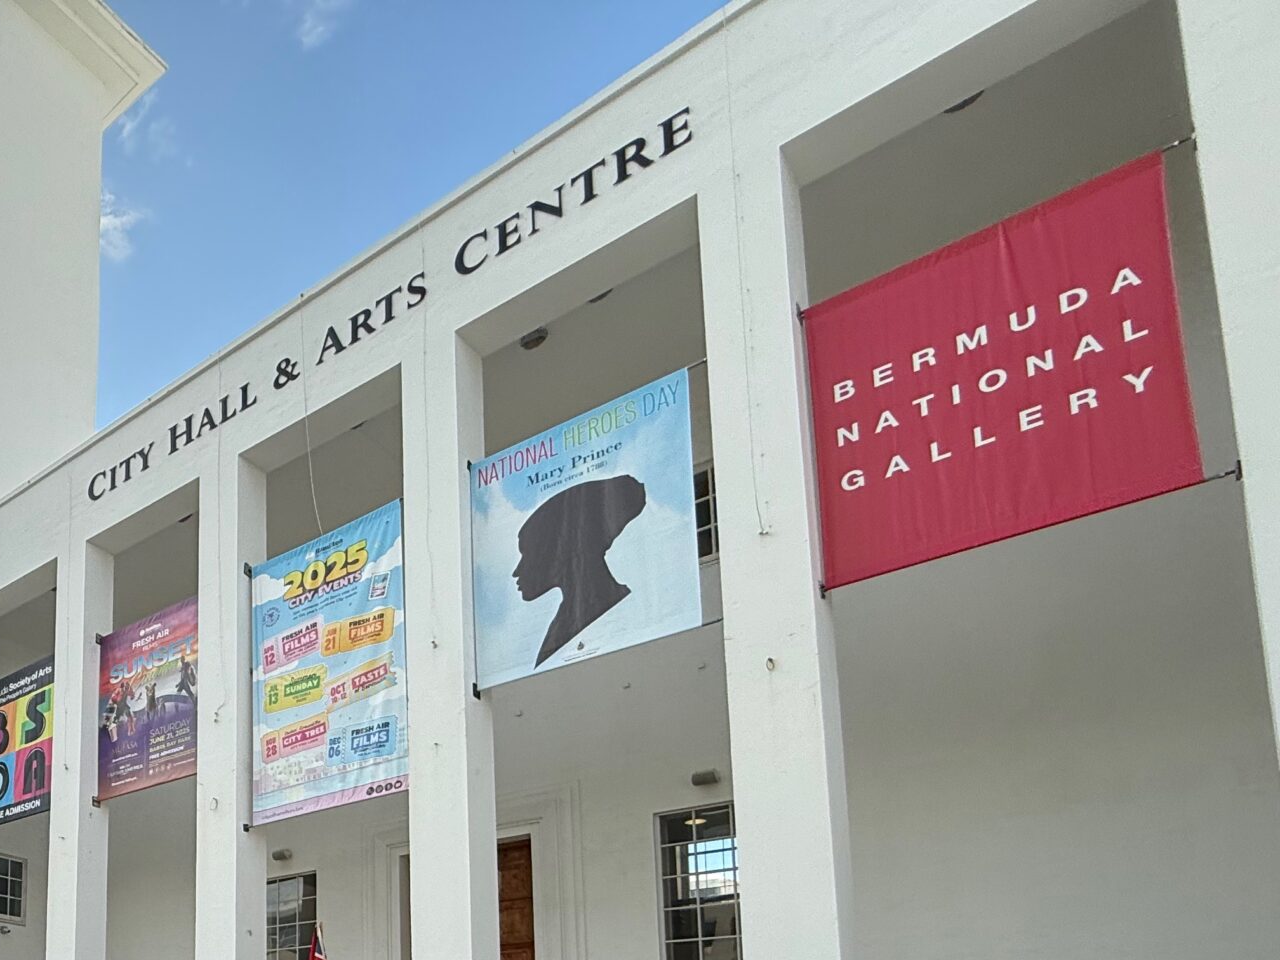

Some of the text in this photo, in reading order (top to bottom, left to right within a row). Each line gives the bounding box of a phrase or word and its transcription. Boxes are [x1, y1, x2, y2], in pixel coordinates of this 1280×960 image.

[87, 106, 693, 502] CITY HALL & ARTS CENTRE
[832, 267, 1143, 403] BERMUDA
[836, 319, 1149, 448] NATIONAL
[478, 379, 680, 489] NATIONAL HEROES DAY
[839, 366, 1154, 492] GALLERY
[526, 440, 623, 489] Mary Prince
[283, 539, 368, 601] 2025
[289, 590, 318, 609] CITY
[318, 572, 363, 598] EVENTS
[349, 613, 384, 628] FRESH AIR
[350, 621, 383, 638] FILMS
[132, 628, 169, 650] FRESH AIR
[282, 622, 317, 642] FRESH AIR
[284, 631, 317, 653] FILMS
[325, 637, 336, 651] 21
[109, 633, 194, 684] SUNSET
[264, 653, 276, 666] 12
[8, 676, 31, 692] Society
[31, 671, 39, 680] of
[38, 666, 52, 678] Arts
[353, 665, 387, 686] TASTE
[285, 679, 319, 695] SUNDAY
[330, 681, 346, 696] OCT
[268, 693, 279, 705] 13
[149, 719, 190, 737] SATURDAY
[351, 721, 390, 736] FRESH AIR
[149, 735, 166, 745] JUNE
[283, 733, 302, 745] CITY
[353, 731, 388, 748] FILMS
[266, 745, 277, 758] 28
[328, 746, 341, 758] 06
[5, 799, 41, 817] ADMISSION
